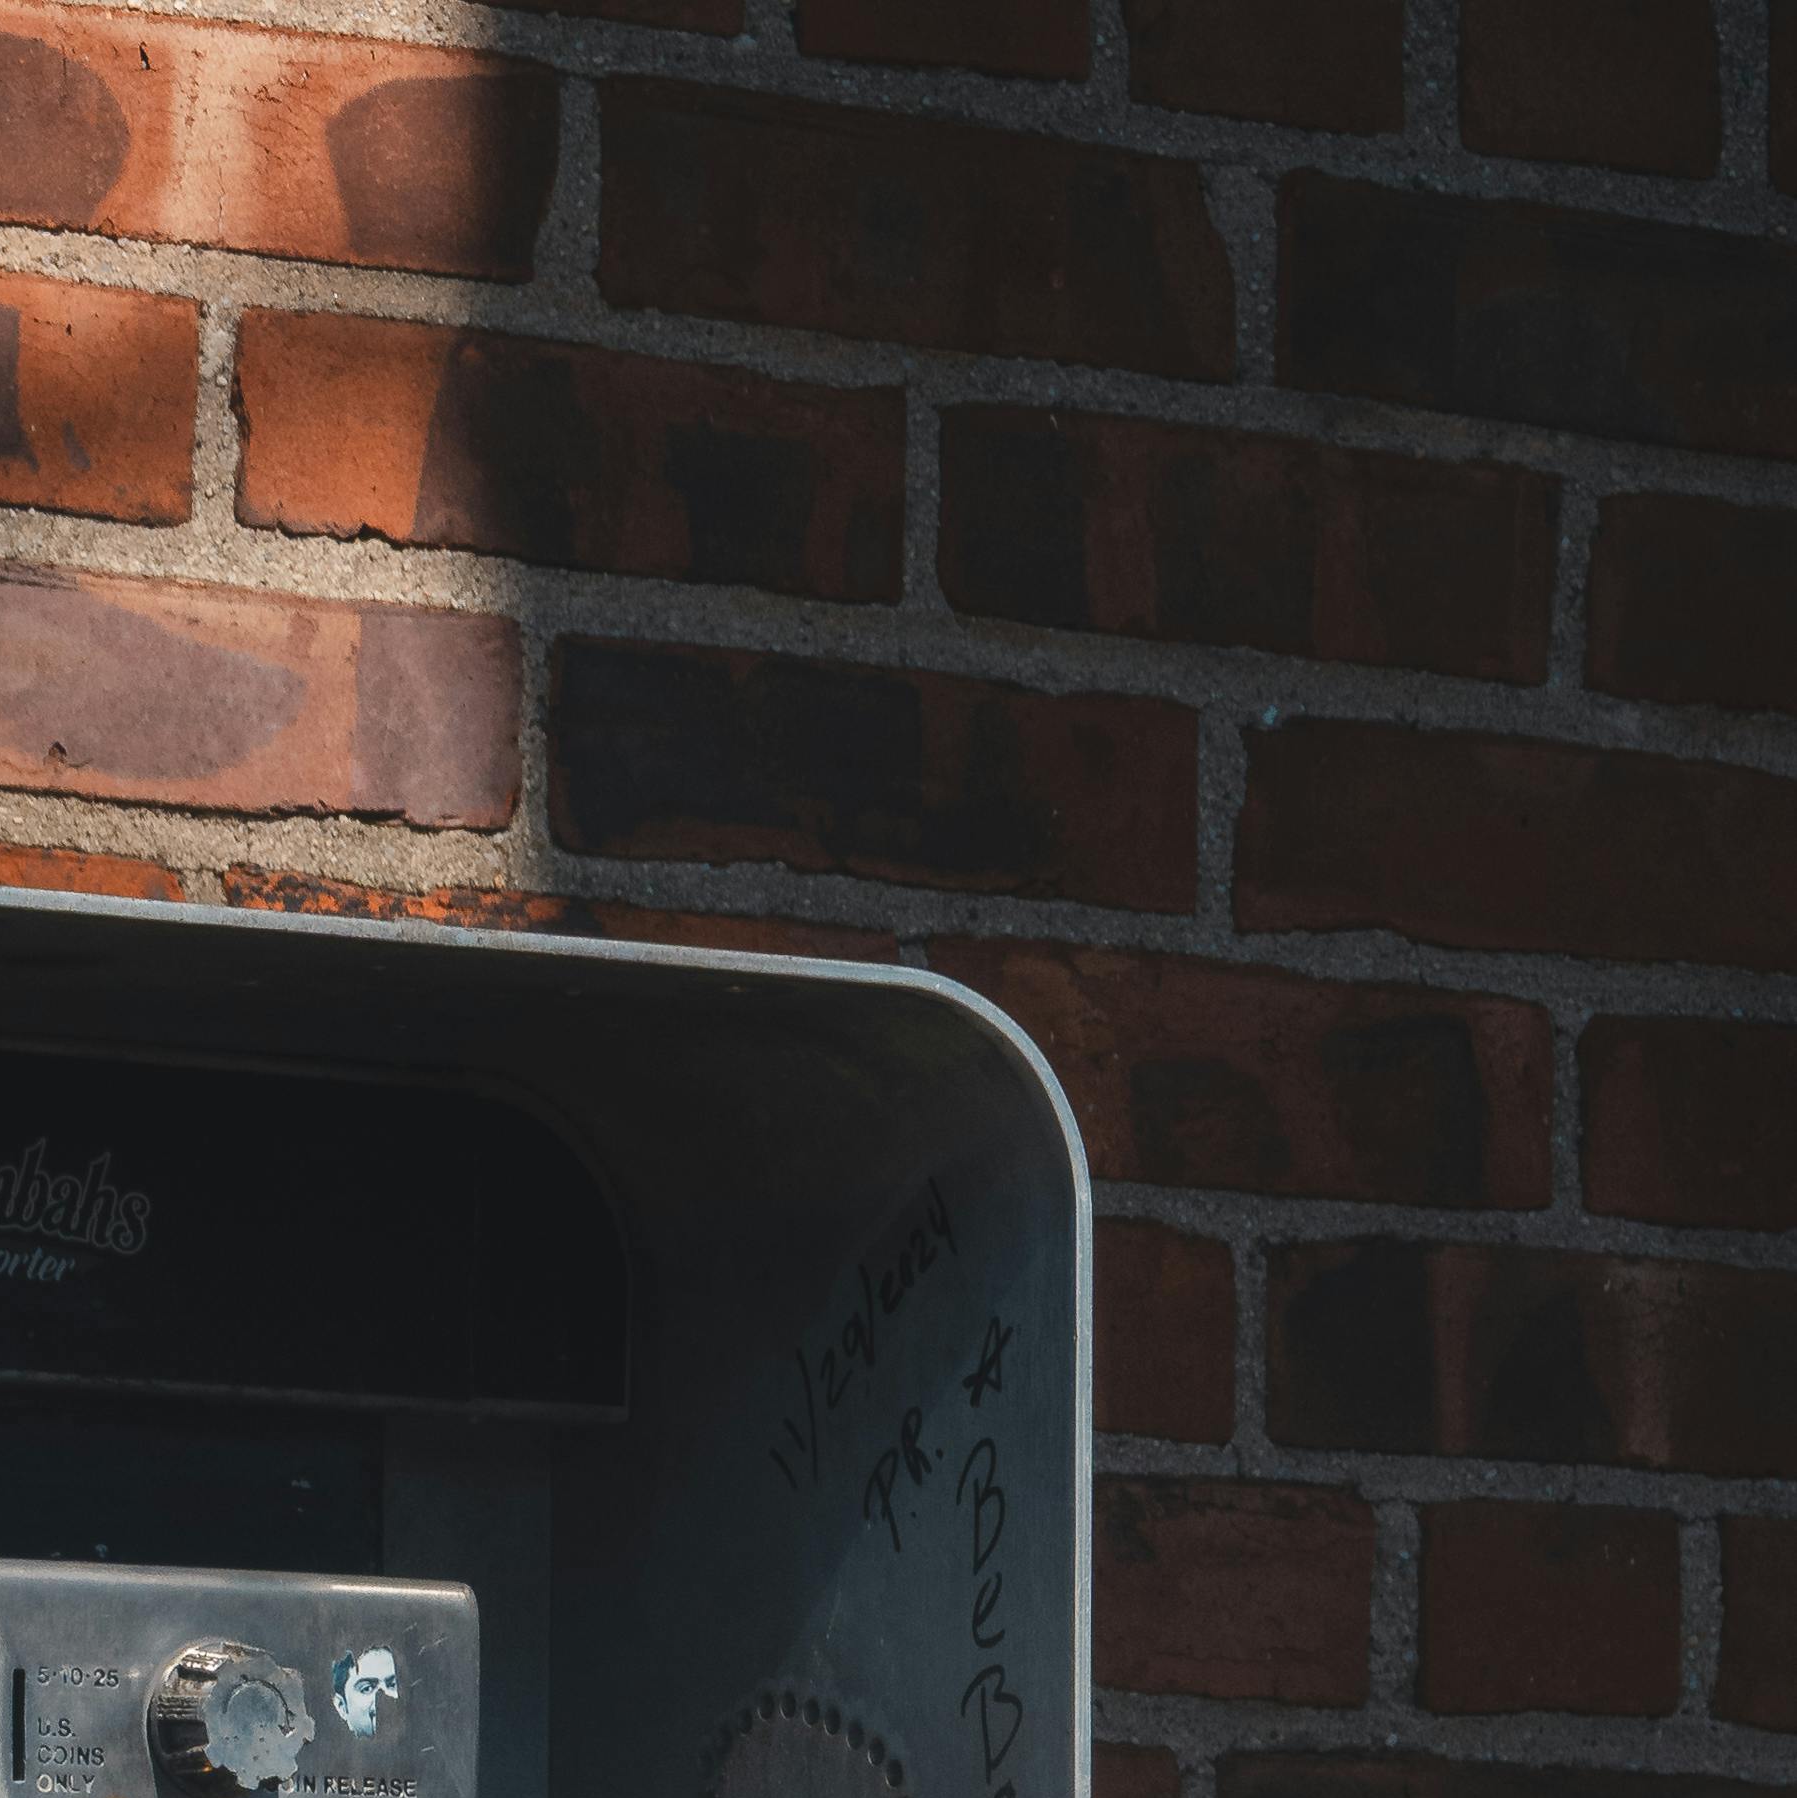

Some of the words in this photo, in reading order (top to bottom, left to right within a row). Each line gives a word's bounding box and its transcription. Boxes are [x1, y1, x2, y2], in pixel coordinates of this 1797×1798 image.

[37, 1717, 76, 1737] U.S.
[37, 1745, 106, 1766] COINS
[36, 1774, 96, 1794] ONLY
